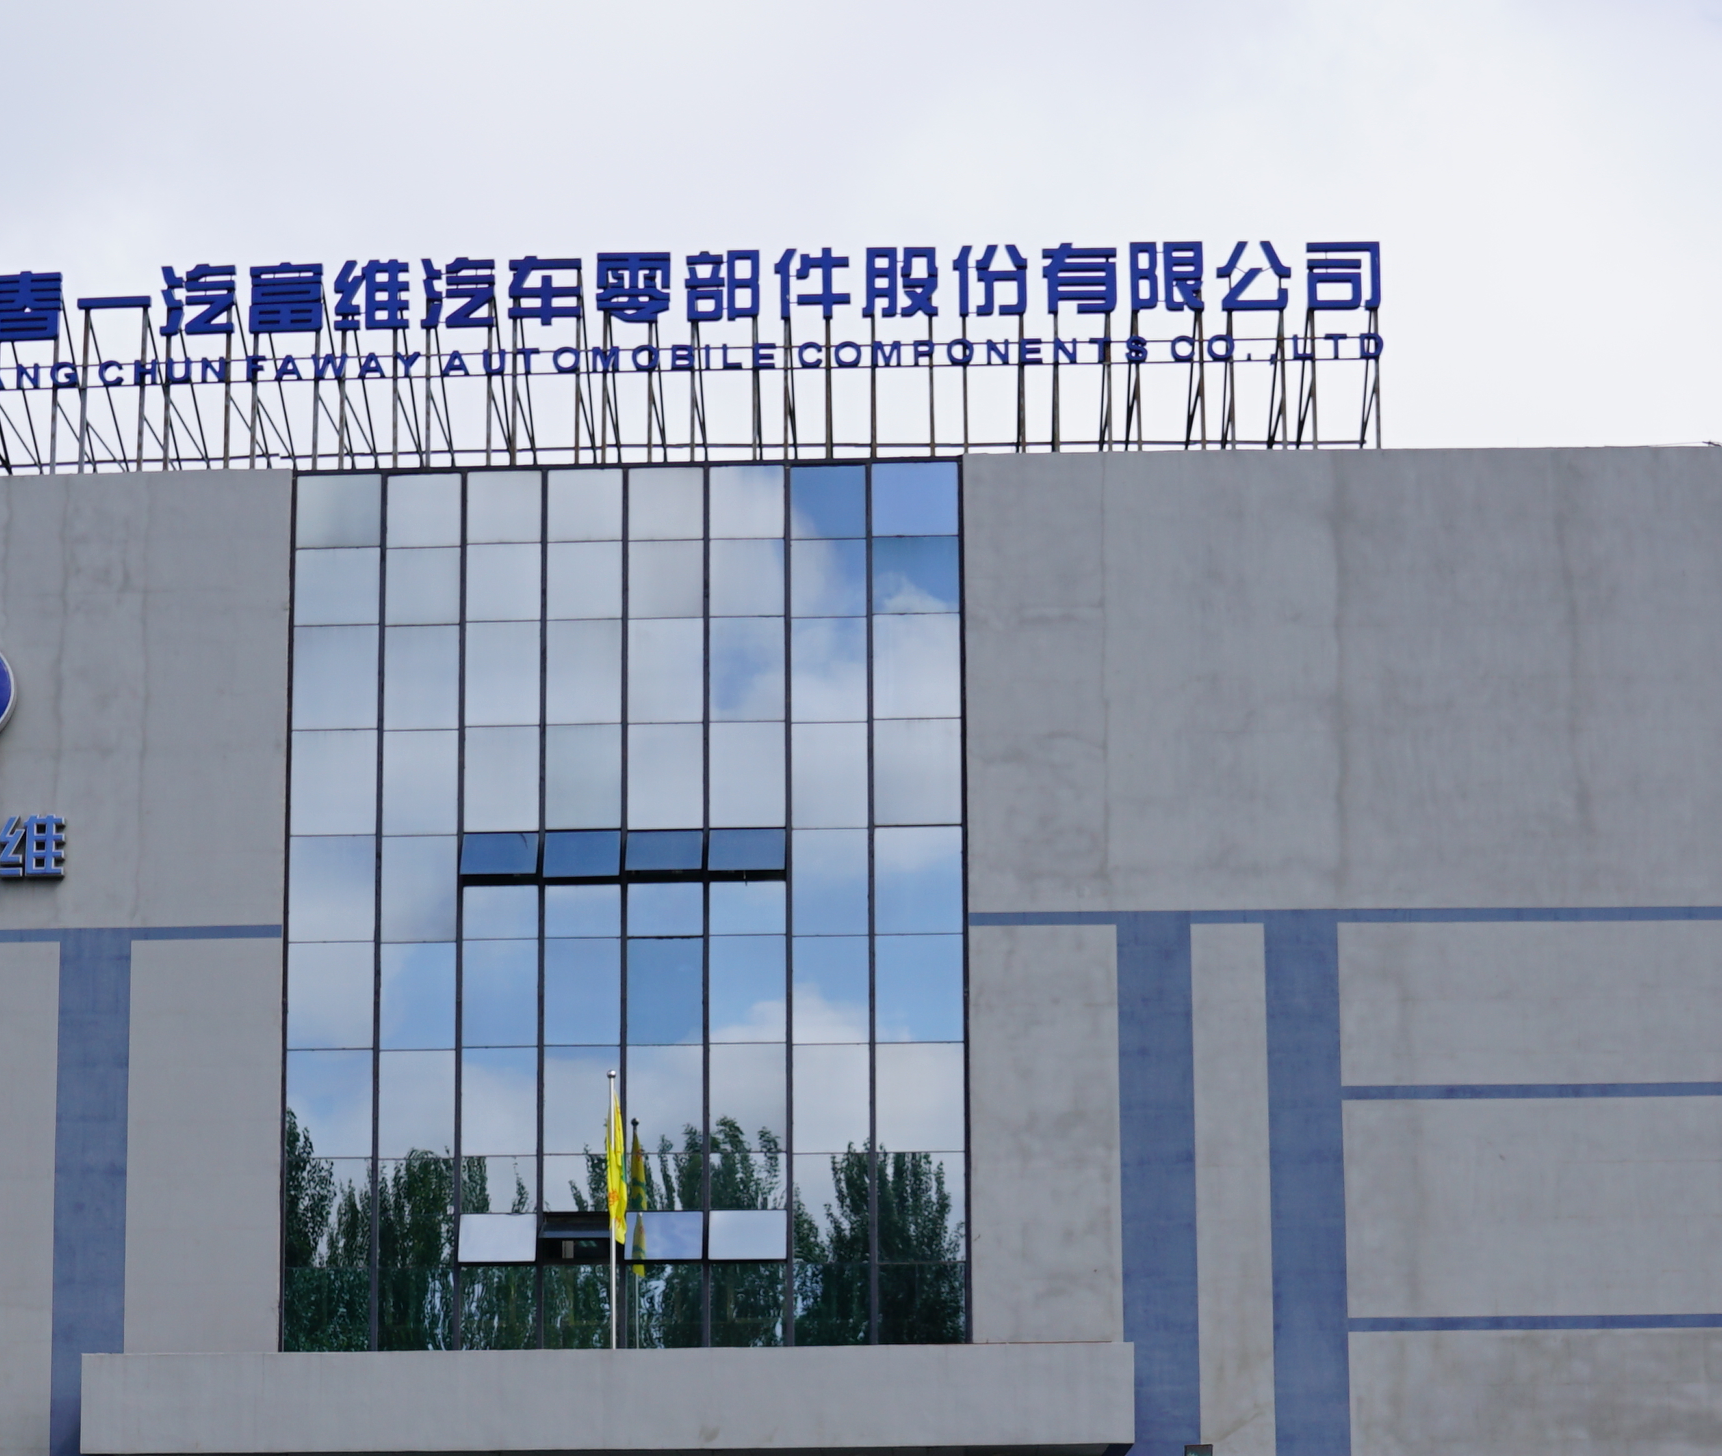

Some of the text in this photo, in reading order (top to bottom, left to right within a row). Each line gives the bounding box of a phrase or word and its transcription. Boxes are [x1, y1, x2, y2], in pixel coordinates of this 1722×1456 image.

[98, 357, 226, 386] CHUN
[245, 351, 421, 379] FAWAY
[441, 342, 777, 375] AUTOMOBILE
[798, 335, 1148, 367] COMPONENTS
